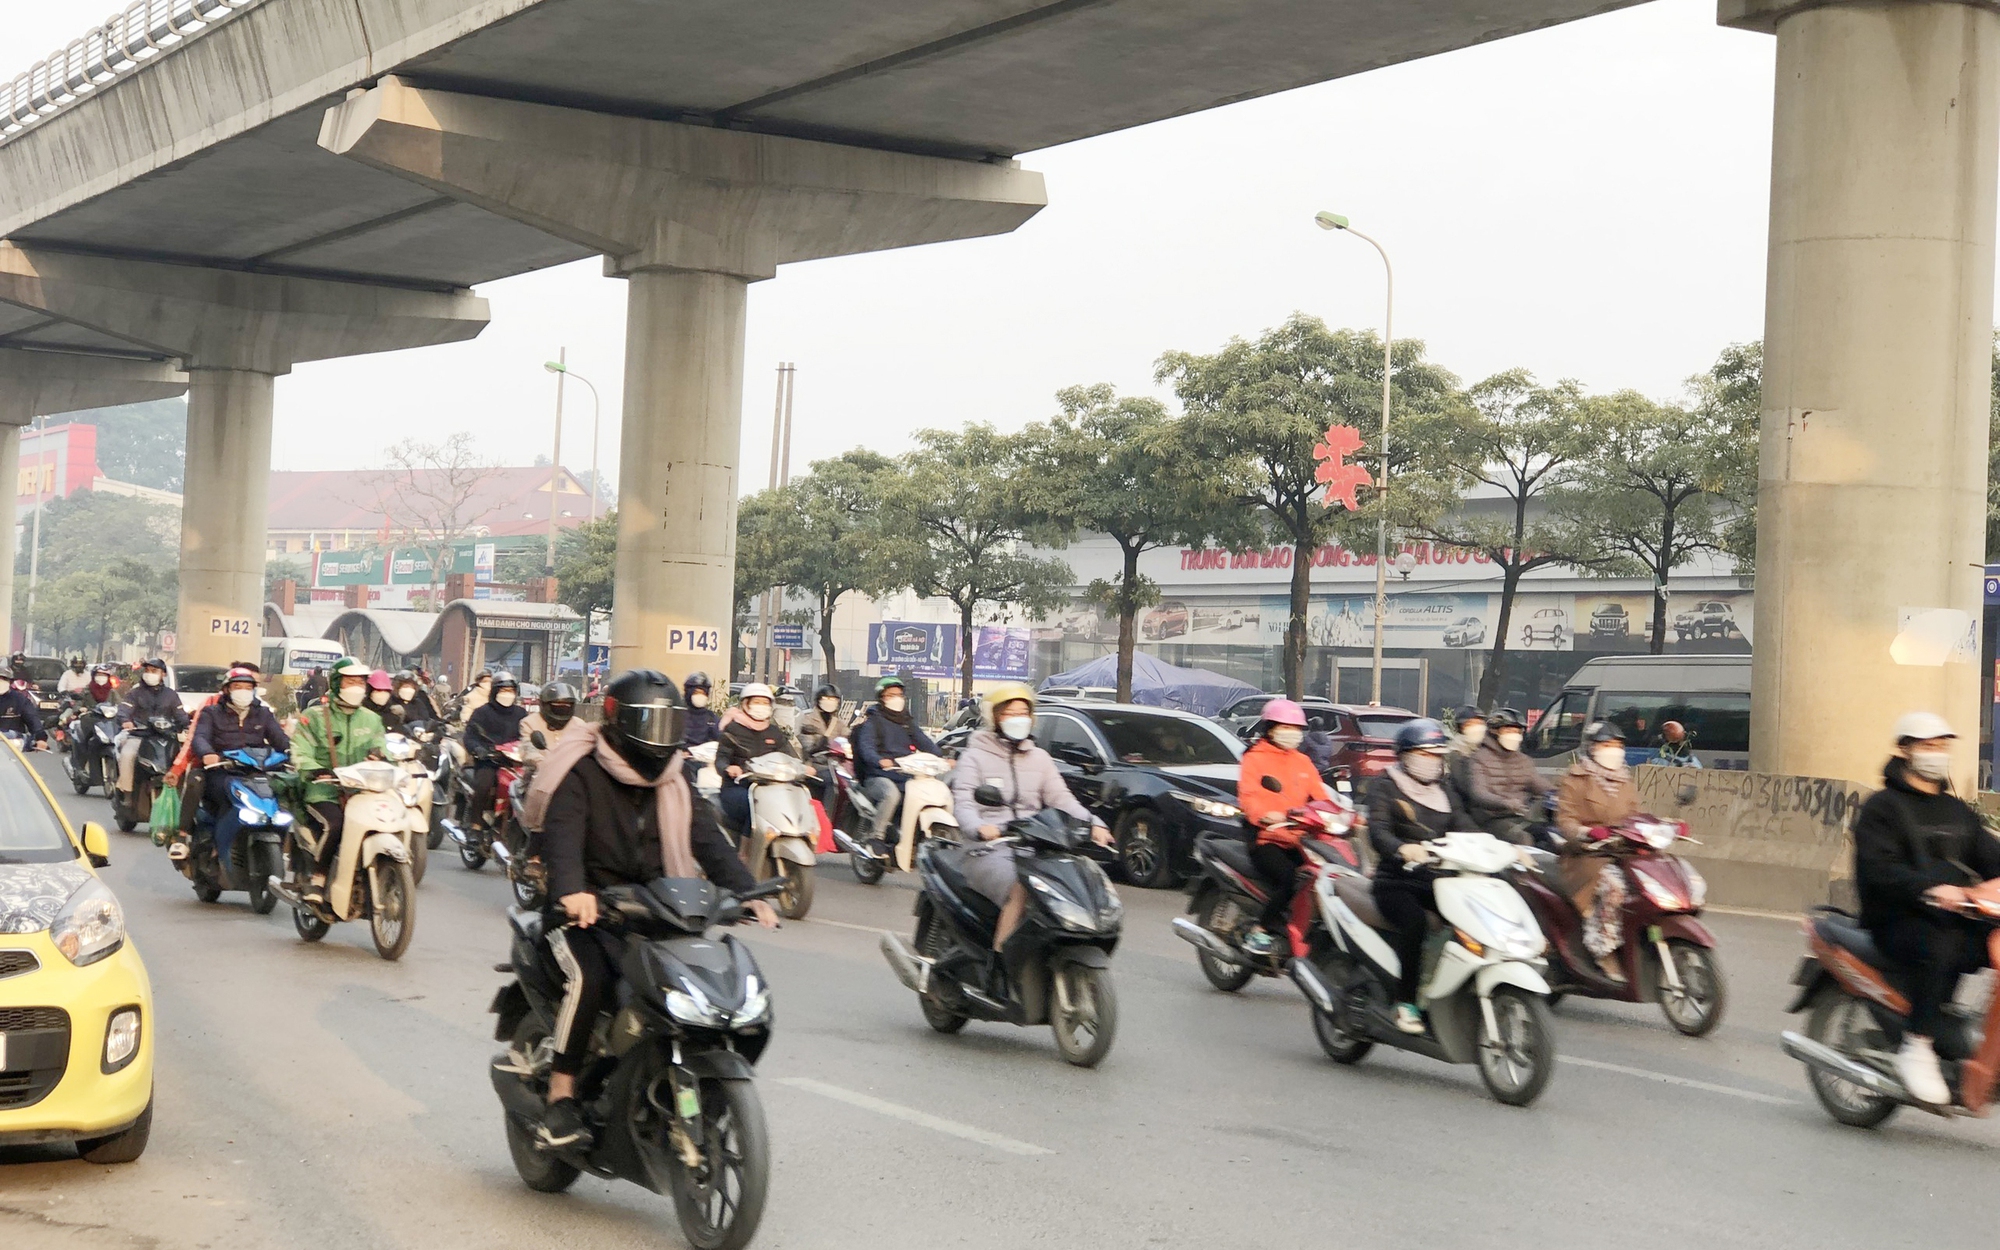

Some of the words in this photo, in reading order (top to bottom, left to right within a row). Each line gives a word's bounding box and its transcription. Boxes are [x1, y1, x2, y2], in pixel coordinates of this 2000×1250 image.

[1181, 548, 1227, 570] TRUNG
[1423, 605, 1453, 614] ALTIS
[212, 619, 249, 634] P142
[670, 630, 718, 651] P143
